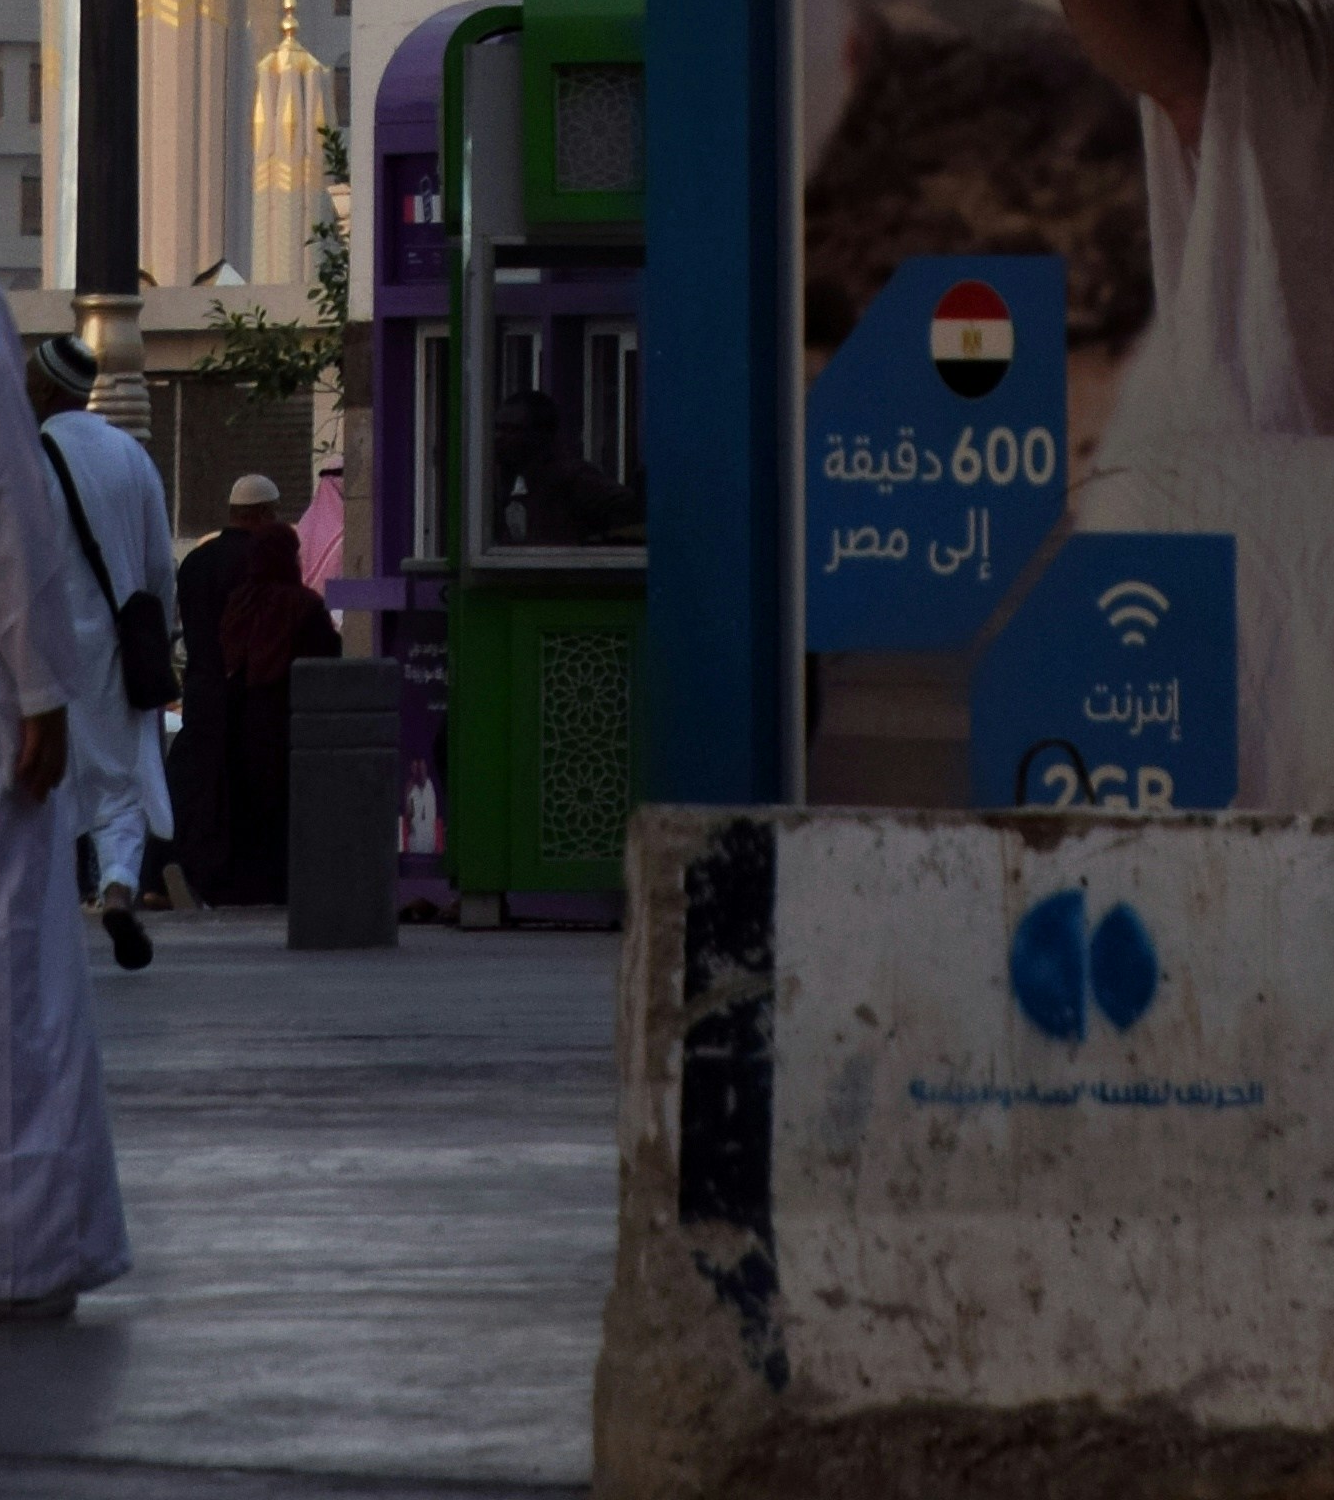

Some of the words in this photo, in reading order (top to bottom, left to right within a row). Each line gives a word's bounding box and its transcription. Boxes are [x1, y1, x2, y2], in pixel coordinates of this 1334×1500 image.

[822, 428, 943, 496] دقيقة
[951, 426, 1056, 486] 600
[823, 522, 909, 579] مصر
[927, 508, 992, 582] إلى
[1083, 676, 1182, 741] إنترنت
